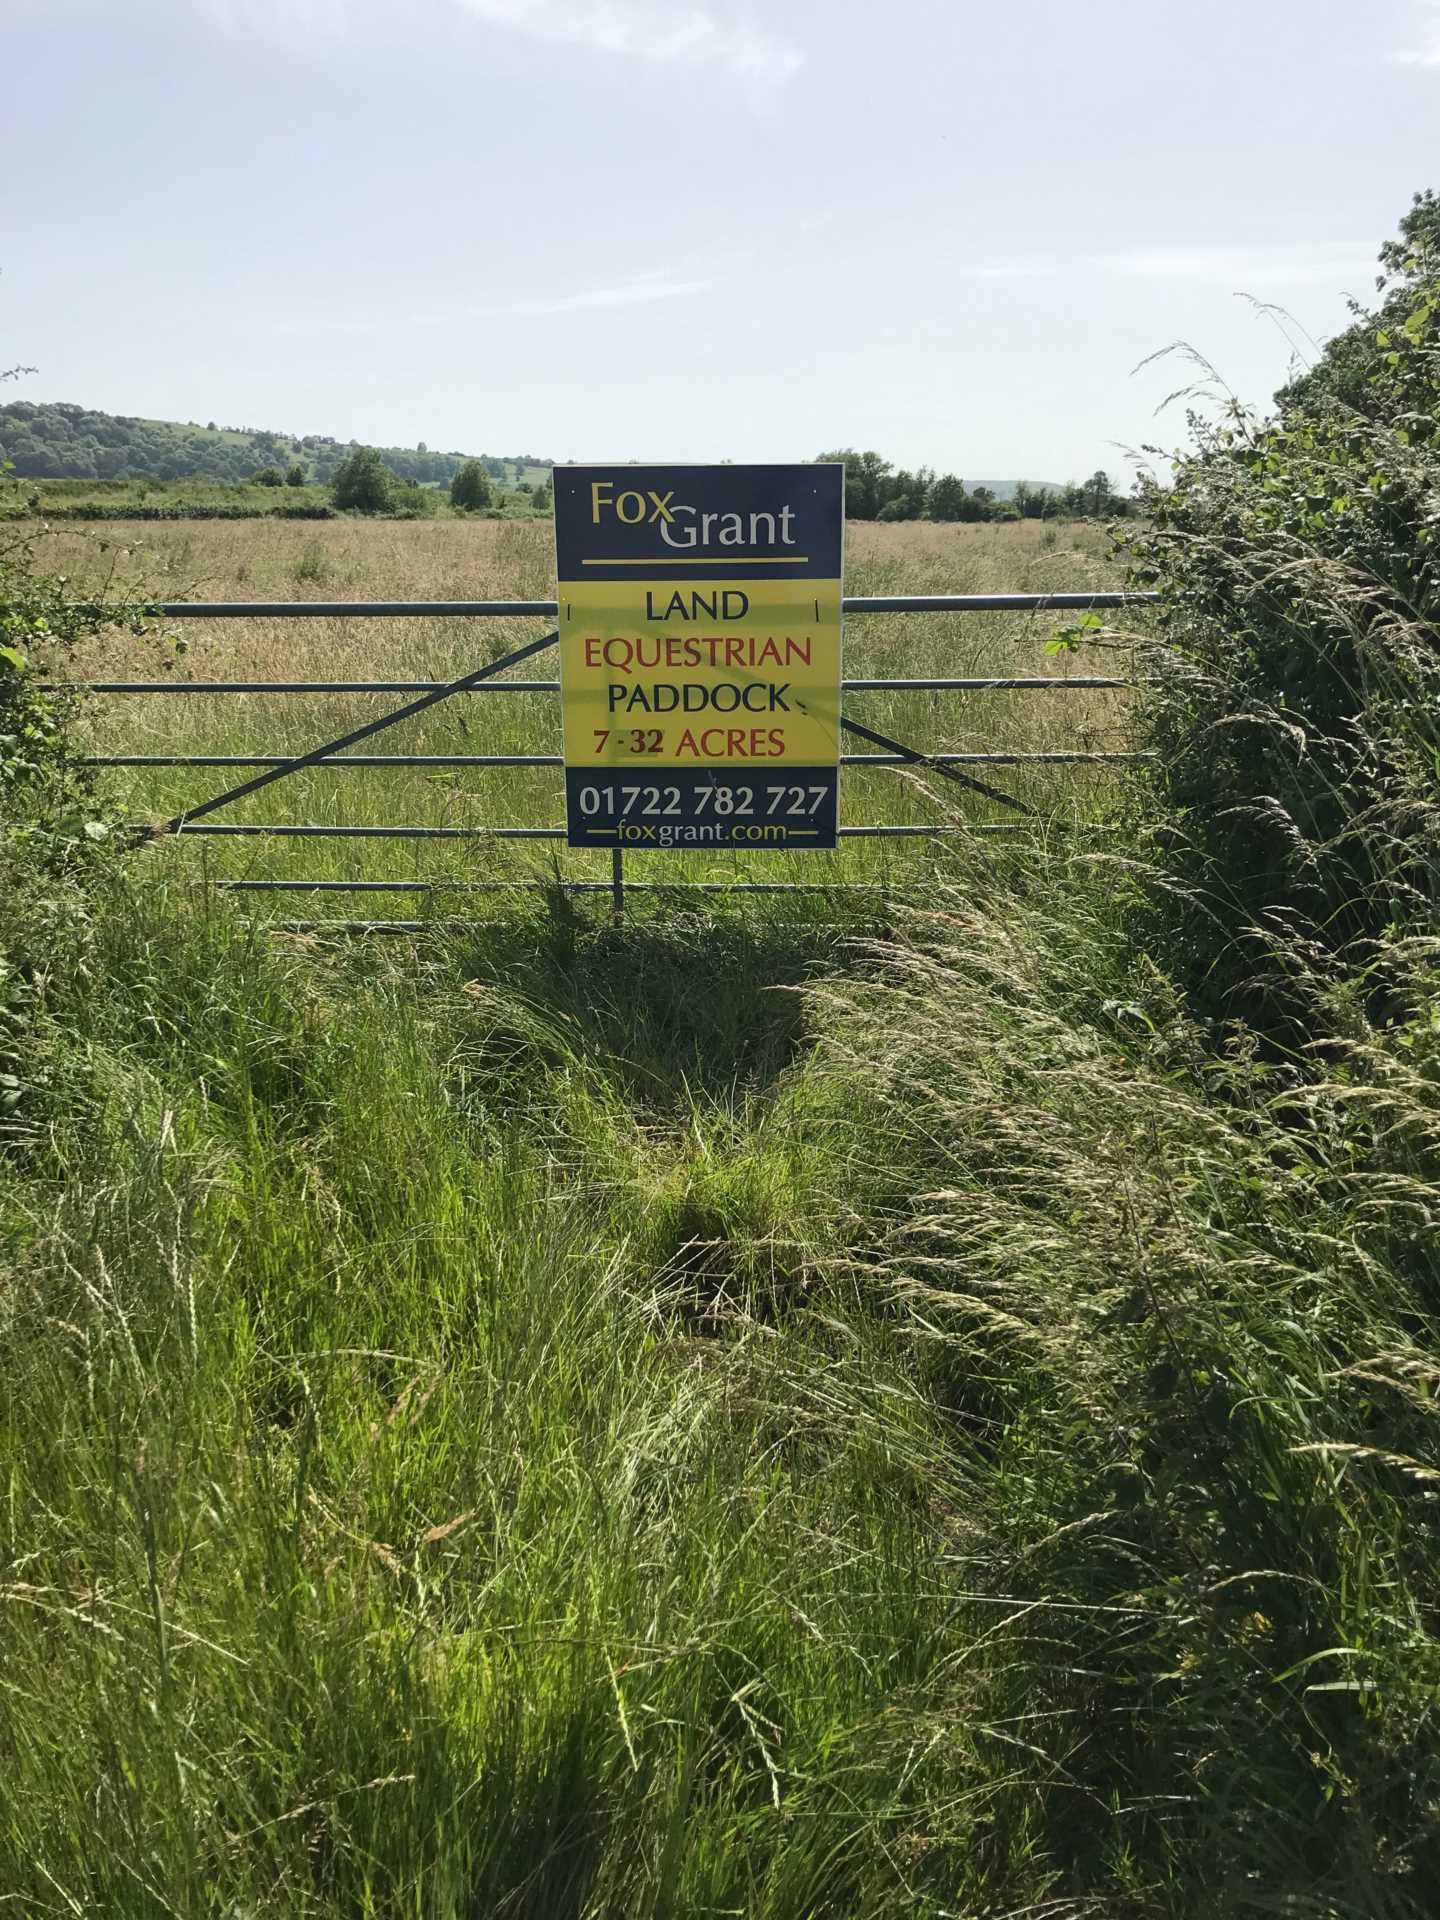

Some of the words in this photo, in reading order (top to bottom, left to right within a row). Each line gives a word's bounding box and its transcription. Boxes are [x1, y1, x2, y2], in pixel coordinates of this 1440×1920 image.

[660, 505, 796, 548] Grant
[646, 591, 749, 621] LAND
[585, 637, 811, 674] EQUESTRIAN
[608, 683, 791, 713] PADDOCK
[675, 729, 785, 757] ACRES
[579, 786, 681, 815] 01722
[694, 786, 753, 815] 782
[766, 786, 828, 815] 727
[615, 819, 787, 847] foxgrant.com
